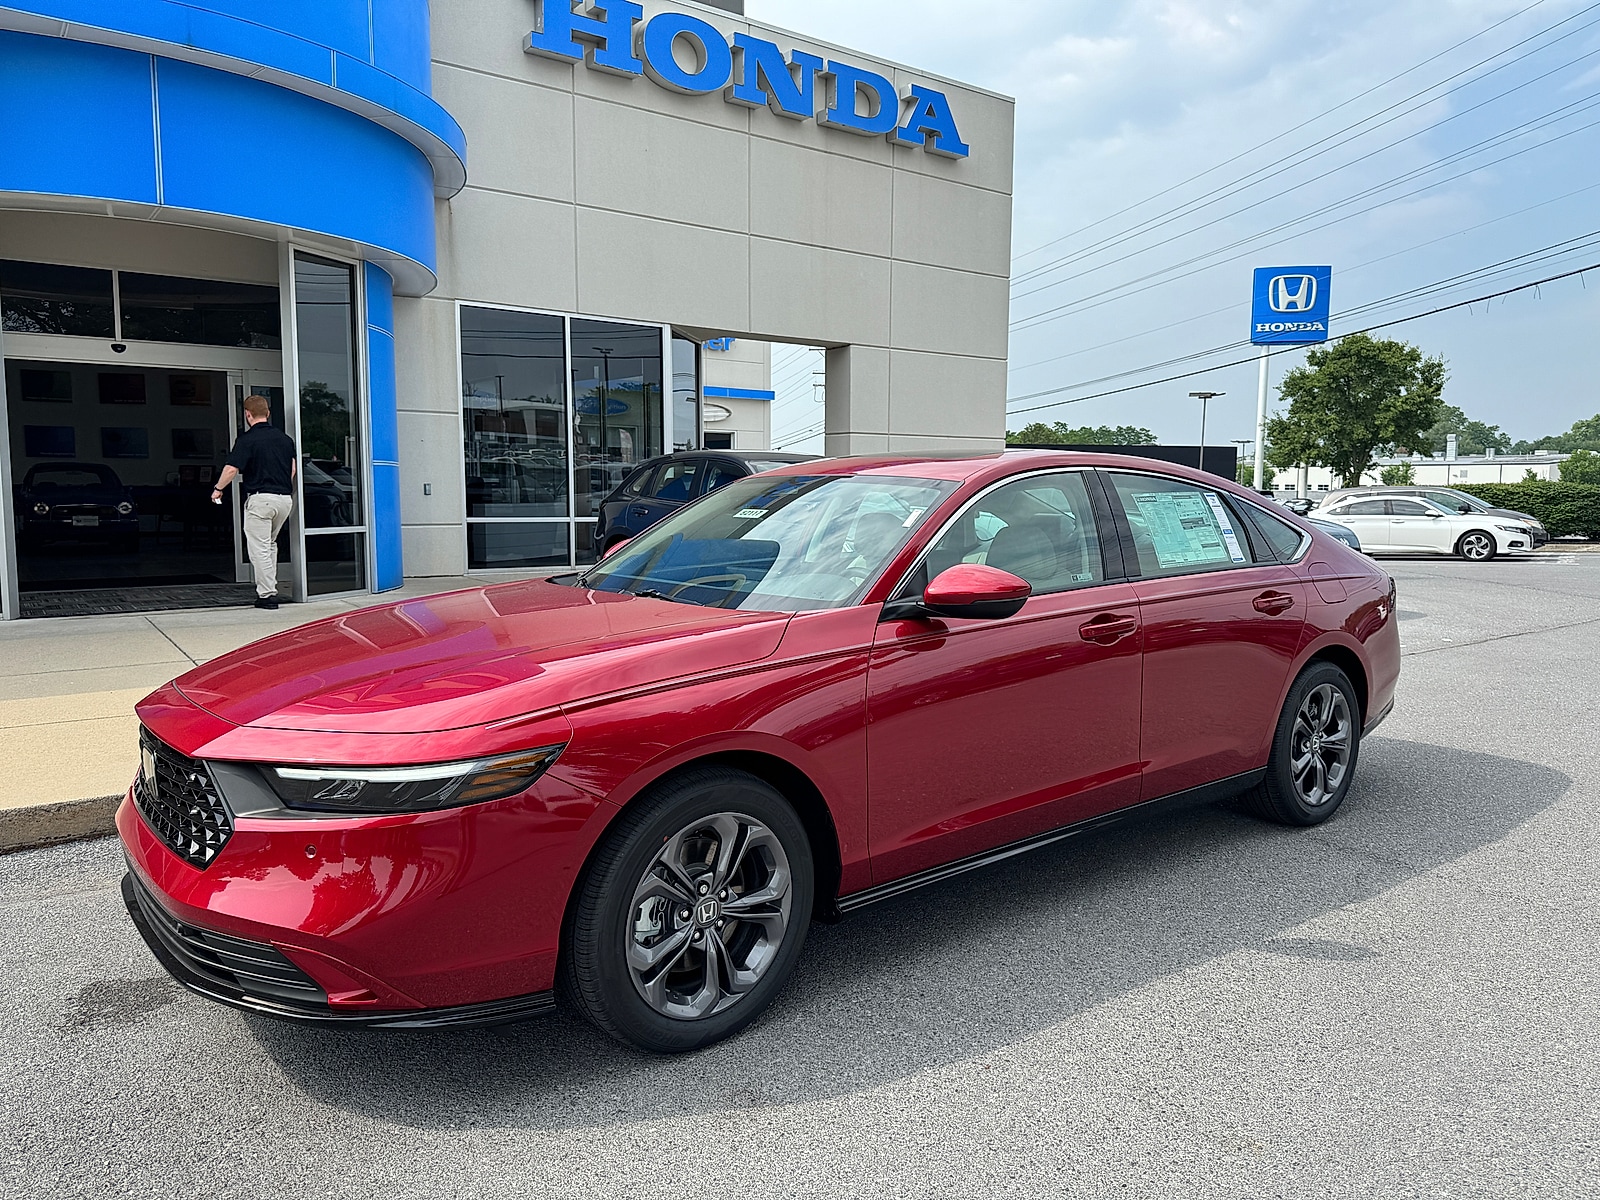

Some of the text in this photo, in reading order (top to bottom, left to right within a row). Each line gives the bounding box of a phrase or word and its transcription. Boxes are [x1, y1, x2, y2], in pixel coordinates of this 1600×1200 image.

[526, 0, 970, 158] HONDA
[1255, 322, 1326, 332] HONDA
[703, 337, 735, 351] er
